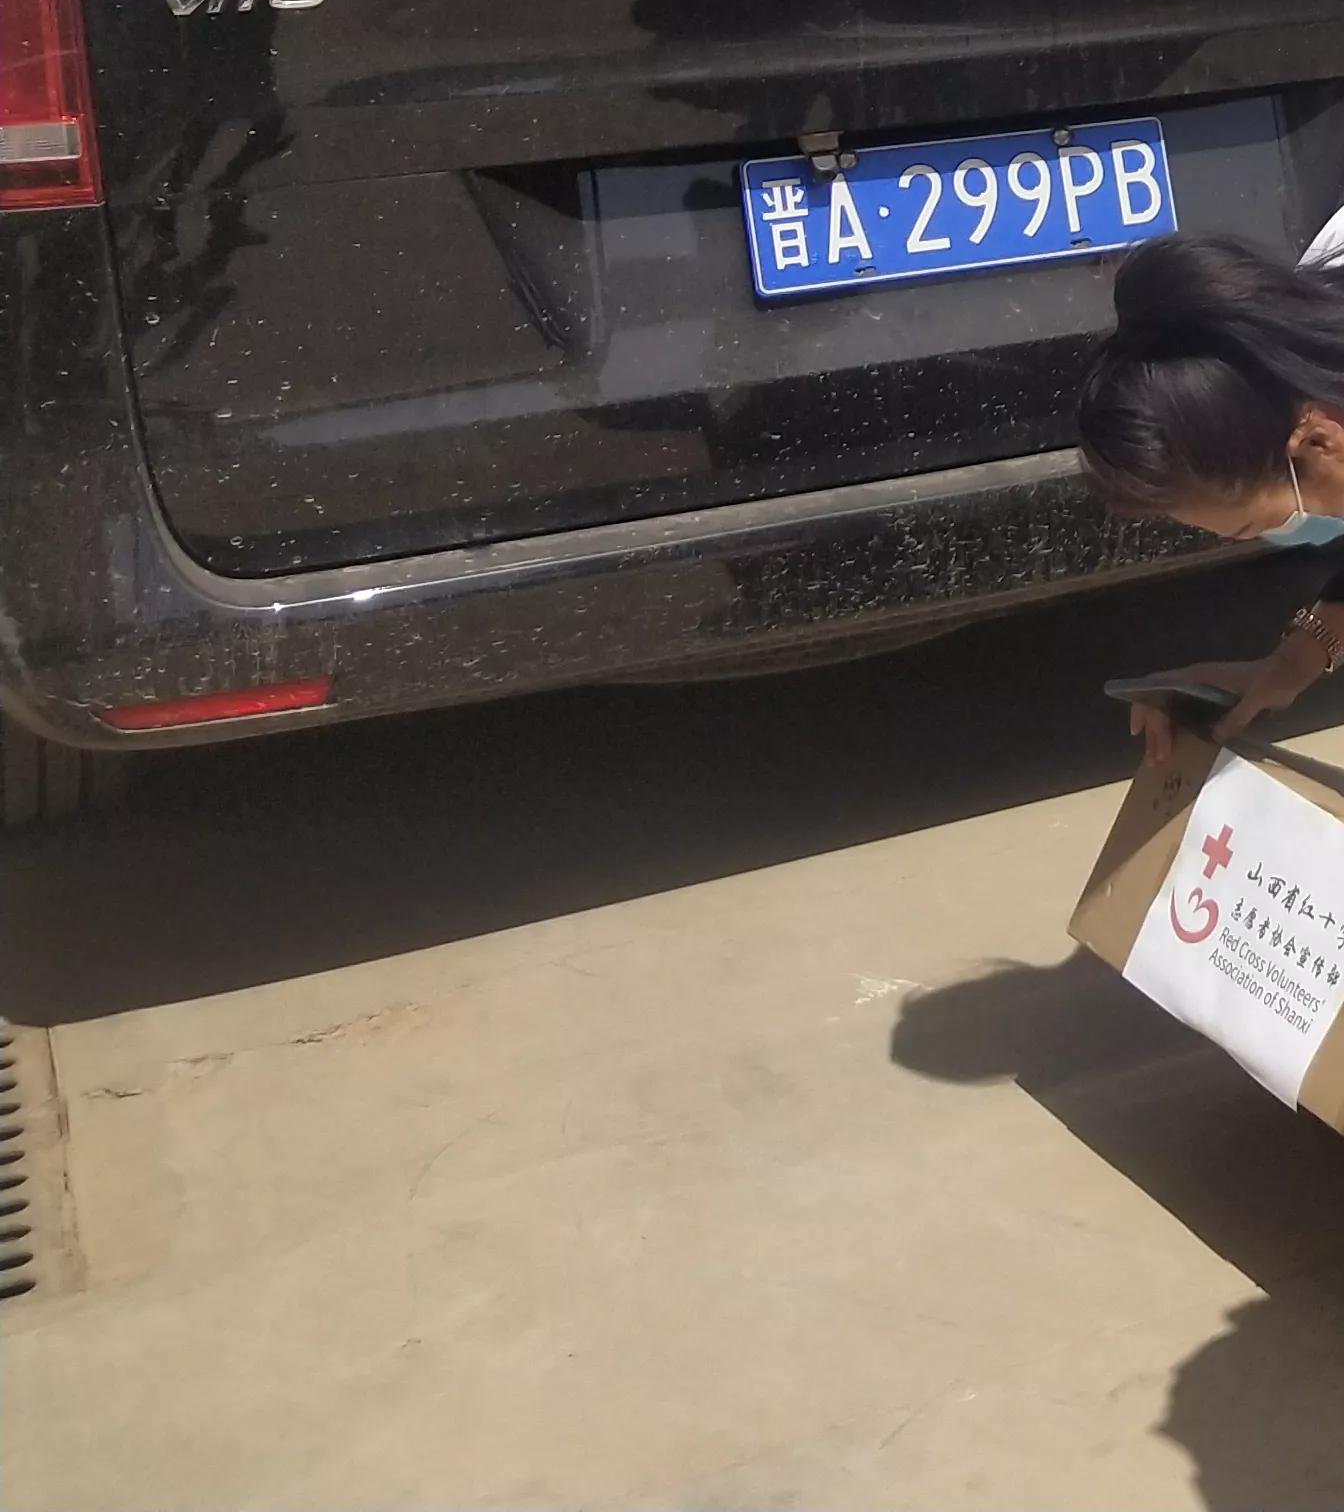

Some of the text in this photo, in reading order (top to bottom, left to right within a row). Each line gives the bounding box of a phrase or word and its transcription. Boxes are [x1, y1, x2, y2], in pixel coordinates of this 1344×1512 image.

[1219, 926, 1242, 952] Red
[1238, 942, 1266, 973] Cross
[1208, 947, 1315, 1035] Association of Shanxi
